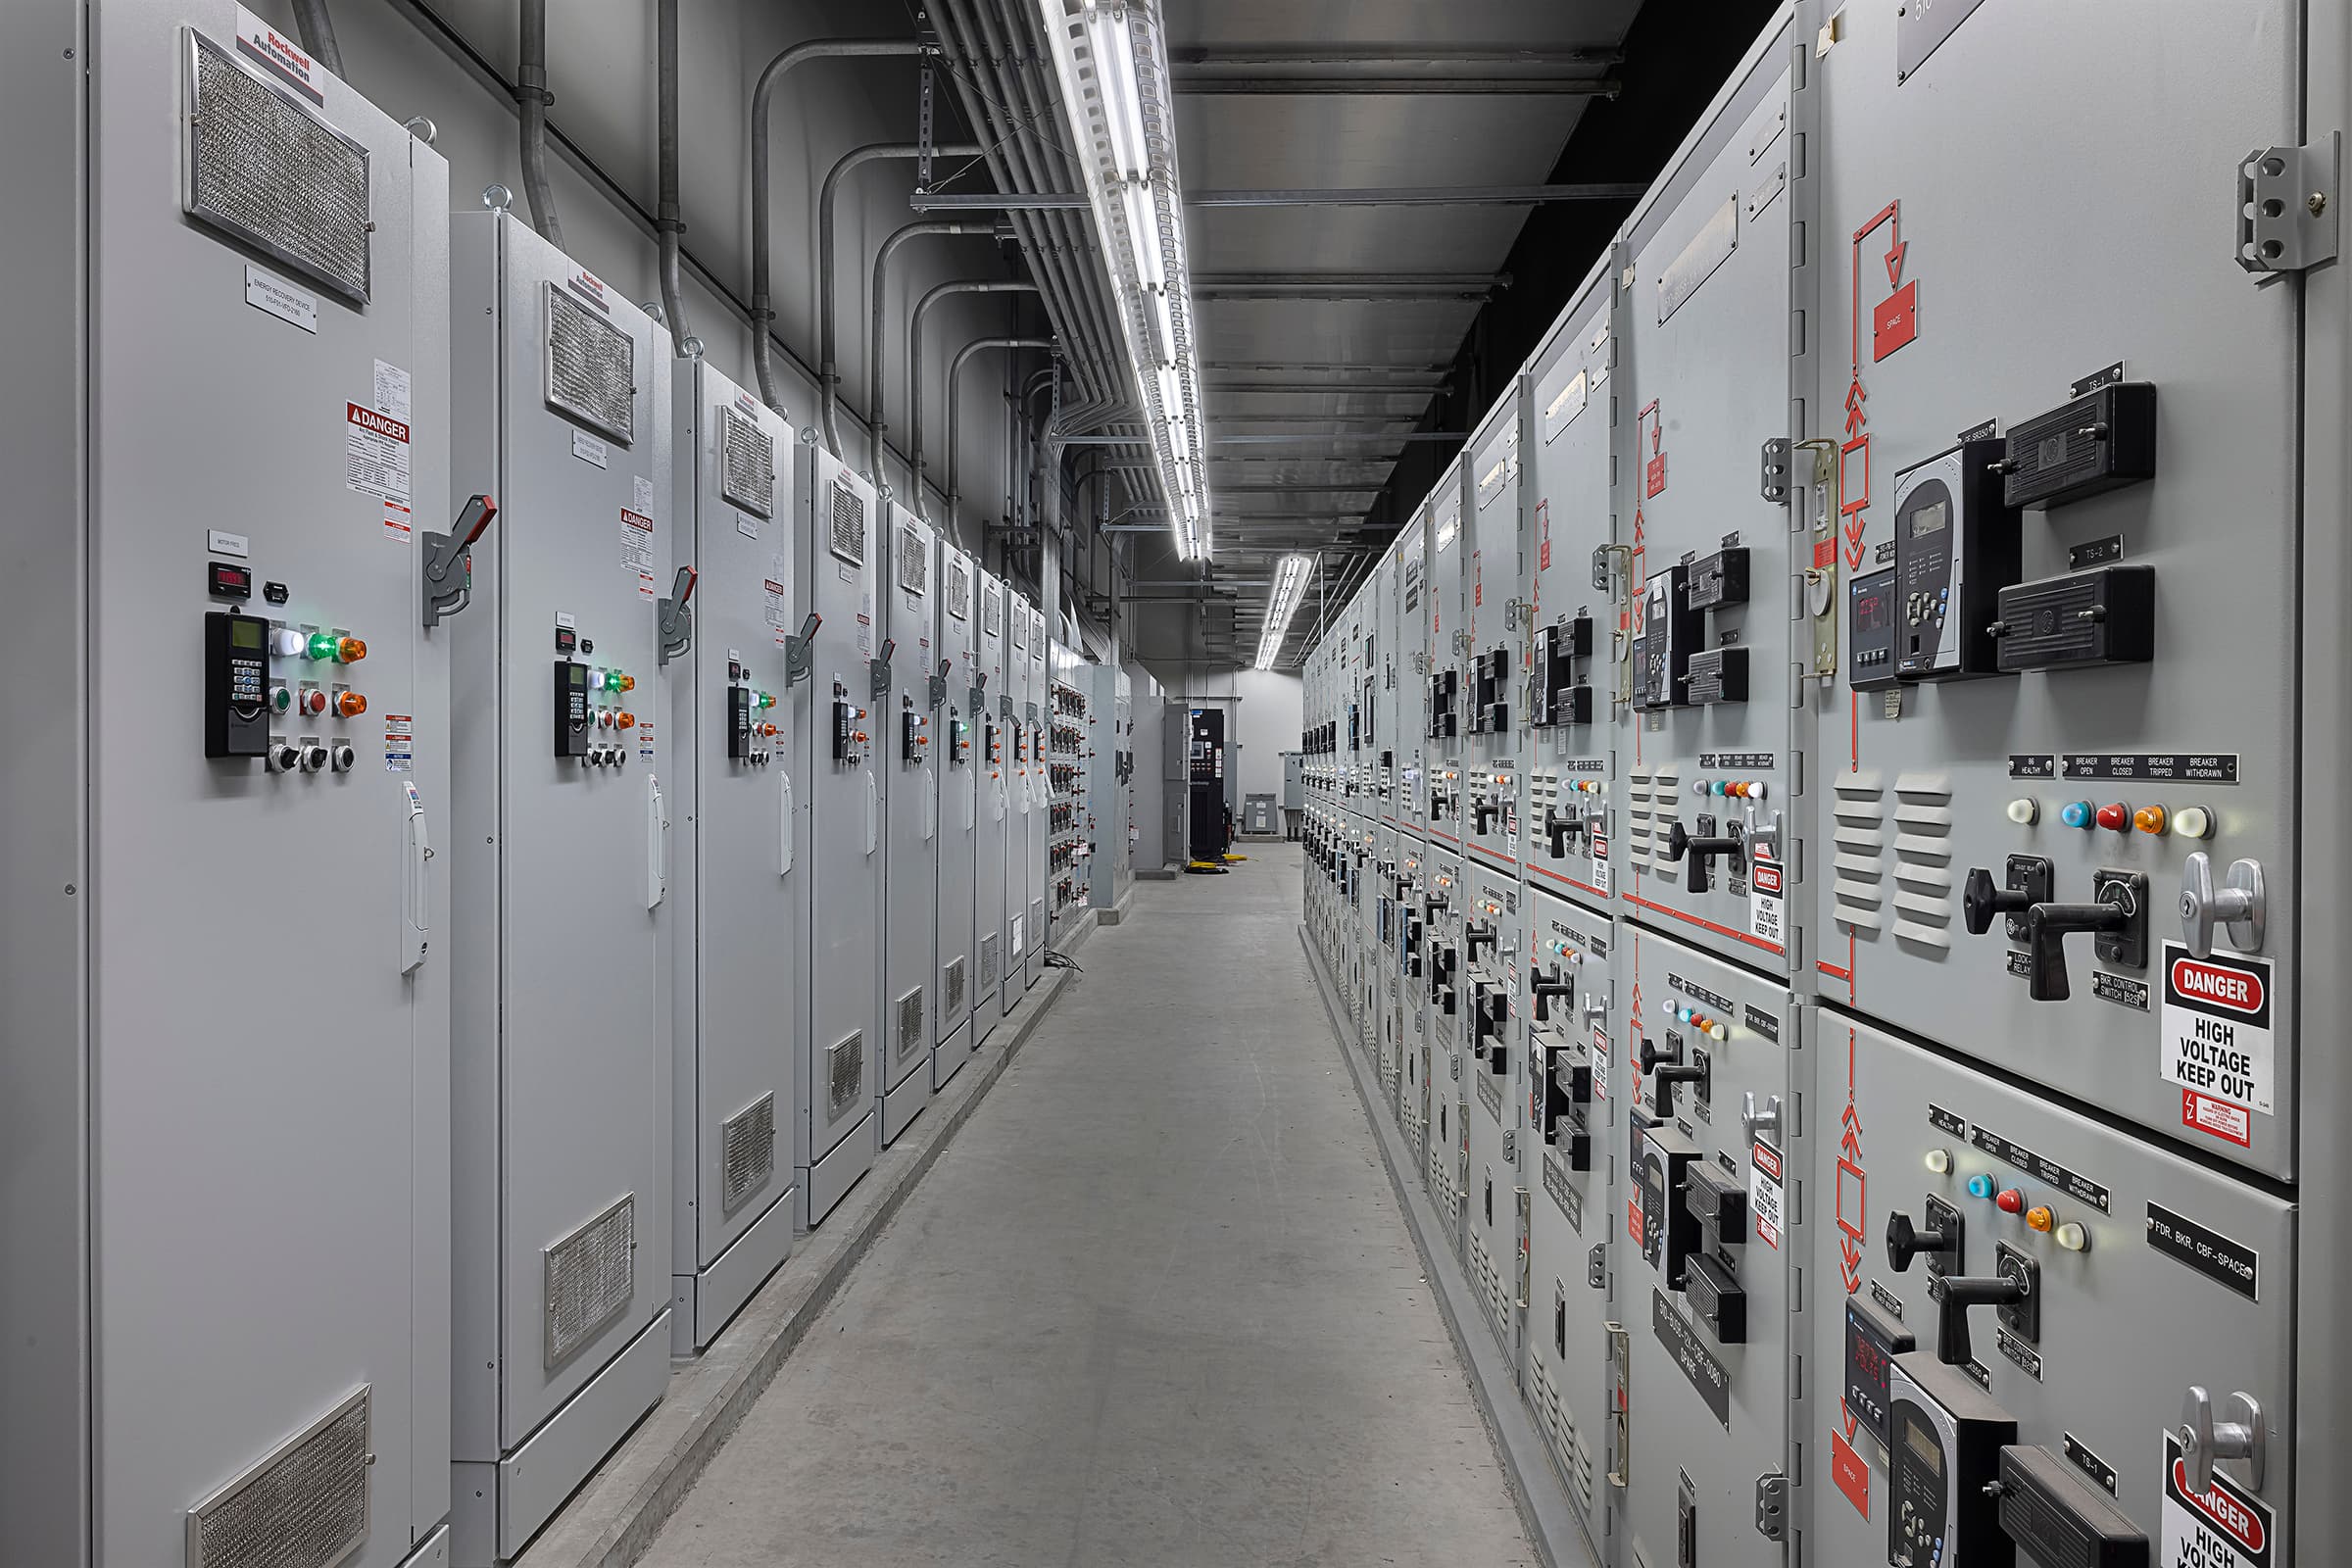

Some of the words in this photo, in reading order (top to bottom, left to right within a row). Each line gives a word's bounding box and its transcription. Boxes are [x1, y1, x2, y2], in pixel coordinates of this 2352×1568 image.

[254, 33, 310, 82] Automation
[268, 31, 310, 71] Rockwell
[1886, 314, 1901, 330] SPACE
[2088, 376, 2105, 390] TS-1
[362, 411, 406, 440] DANGER
[2085, 547, 2103, 559] TS-2
[2147, 758, 2174, 766] BREAKER
[2189, 758, 2218, 766] BREAKER
[2112, 767, 2133, 776] CLOSED
[2149, 767, 2173, 777] TRIPPED
[2185, 768, 2223, 778] WITHDRAWN
[1757, 871, 1778, 886] DANGER
[1760, 898, 1774, 911] HIGH
[1756, 909, 1778, 926] VOLTAGE
[1755, 922, 1768, 935] KEEP
[1768, 926, 1779, 940] OUT
[2014, 954, 2032, 964] LOCK-
[2100, 986, 2123, 1000] SWITCH
[2114, 978, 2139, 994] CONTROL
[2183, 968, 2248, 1003] DANGER
[2195, 1017, 2234, 1047] HIGH
[2180, 1037, 2251, 1076] VOLTAGE
[2177, 1059, 2216, 1089] KEEP
[2221, 1074, 2255, 1102] OUT
[1982, 1132, 2000, 1146] BREAKER
[1985, 1143, 1996, 1153] OPEN
[2010, 1145, 2030, 1160] BREAKER
[2011, 1155, 2028, 1169] CLOSED
[2039, 1159, 2060, 1175] BREAKER
[2040, 1169, 2059, 1185] TRIPPED
[2072, 1176, 2094, 1193] BREAKER
[1755, 1185, 1778, 1213] VOLTAGE
[2068, 1184, 2097, 1205] WITHDRAWN
[1768, 1209, 1779, 1225] OUT
[2155, 1221, 2173, 1240] FDR.
[2175, 1231, 2193, 1250] BKR.
[2196, 1242, 2246, 1277] CBF-SPACE
[2003, 1344, 2021, 1361] SWITCH
[1680, 1347, 1696, 1379] SPARE
[2082, 1452, 2098, 1473] TS-1
[2185, 1481, 2249, 1539] NGER
[2196, 1526, 2234, 1568] HIGH
